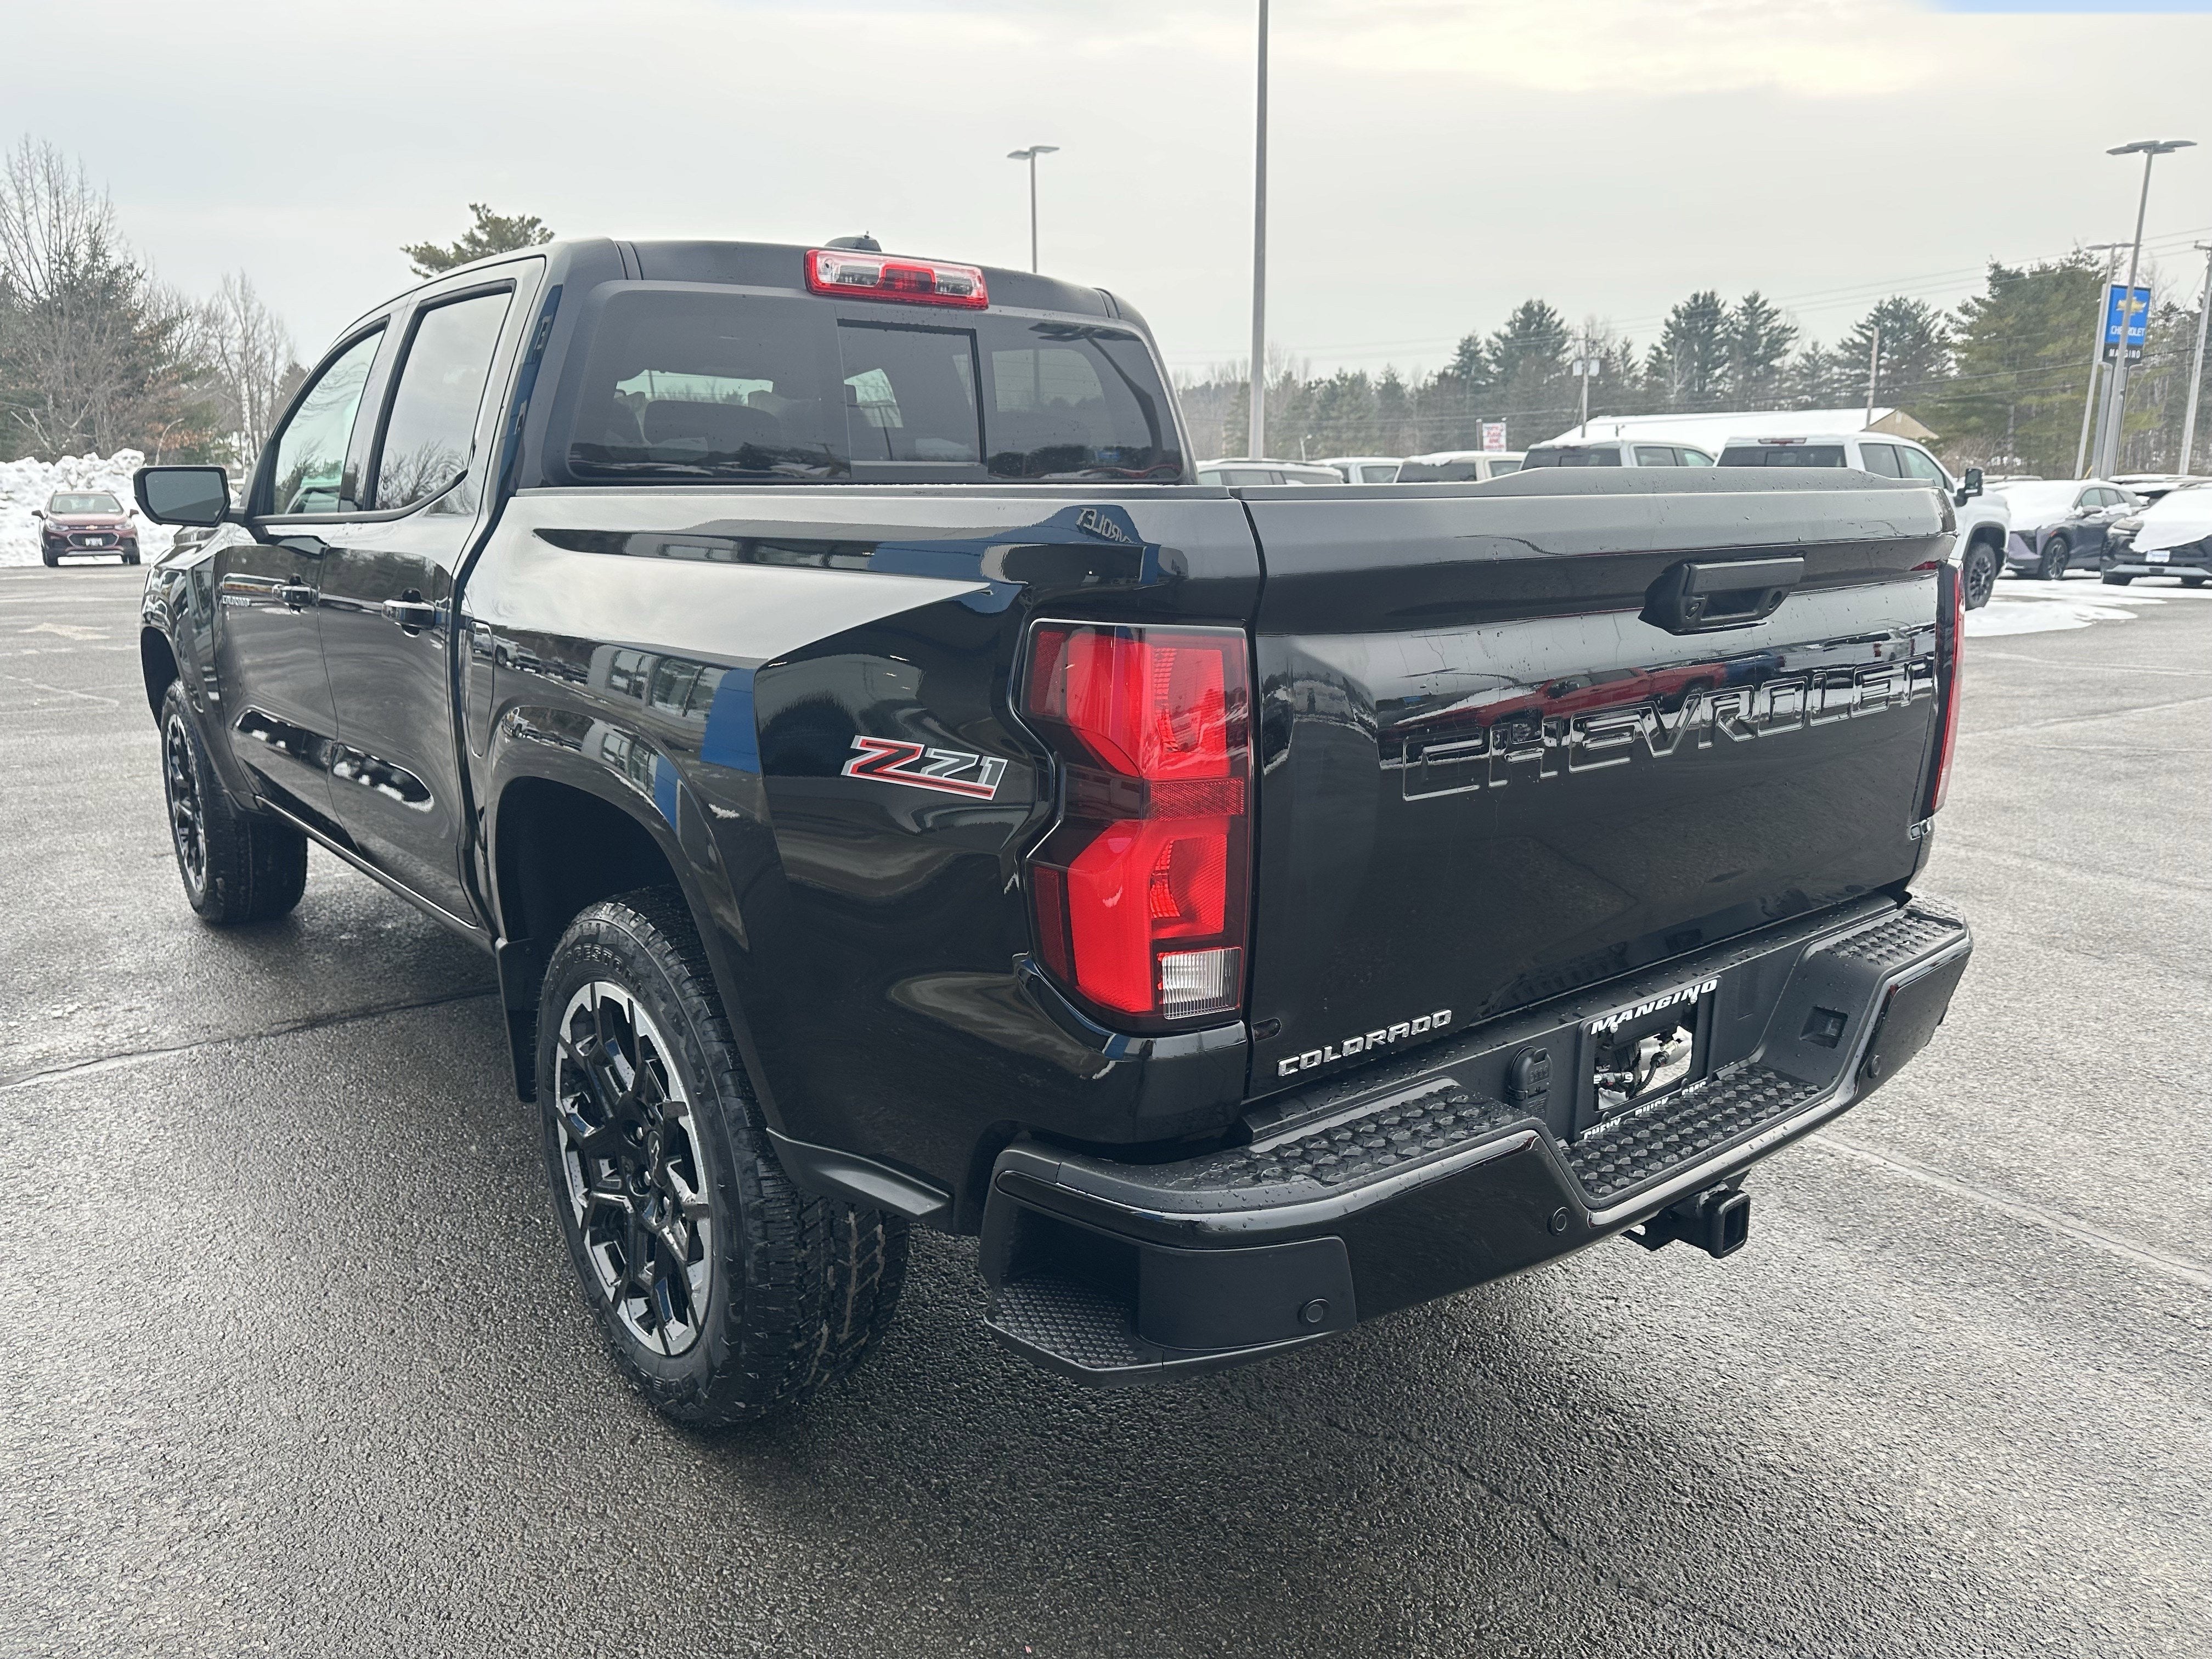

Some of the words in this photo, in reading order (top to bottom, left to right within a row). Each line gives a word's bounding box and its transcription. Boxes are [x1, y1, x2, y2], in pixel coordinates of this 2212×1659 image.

[2109, 348, 2141, 359] MAGINO
[2111, 325, 2146, 336] CHEROLET
[1402, 654, 1927, 802] CHEVROLET
[840, 735, 1008, 801] Z71
[1590, 979, 1718, 1035] MANGINO
[1277, 1008, 1452, 1076] COLORADO
